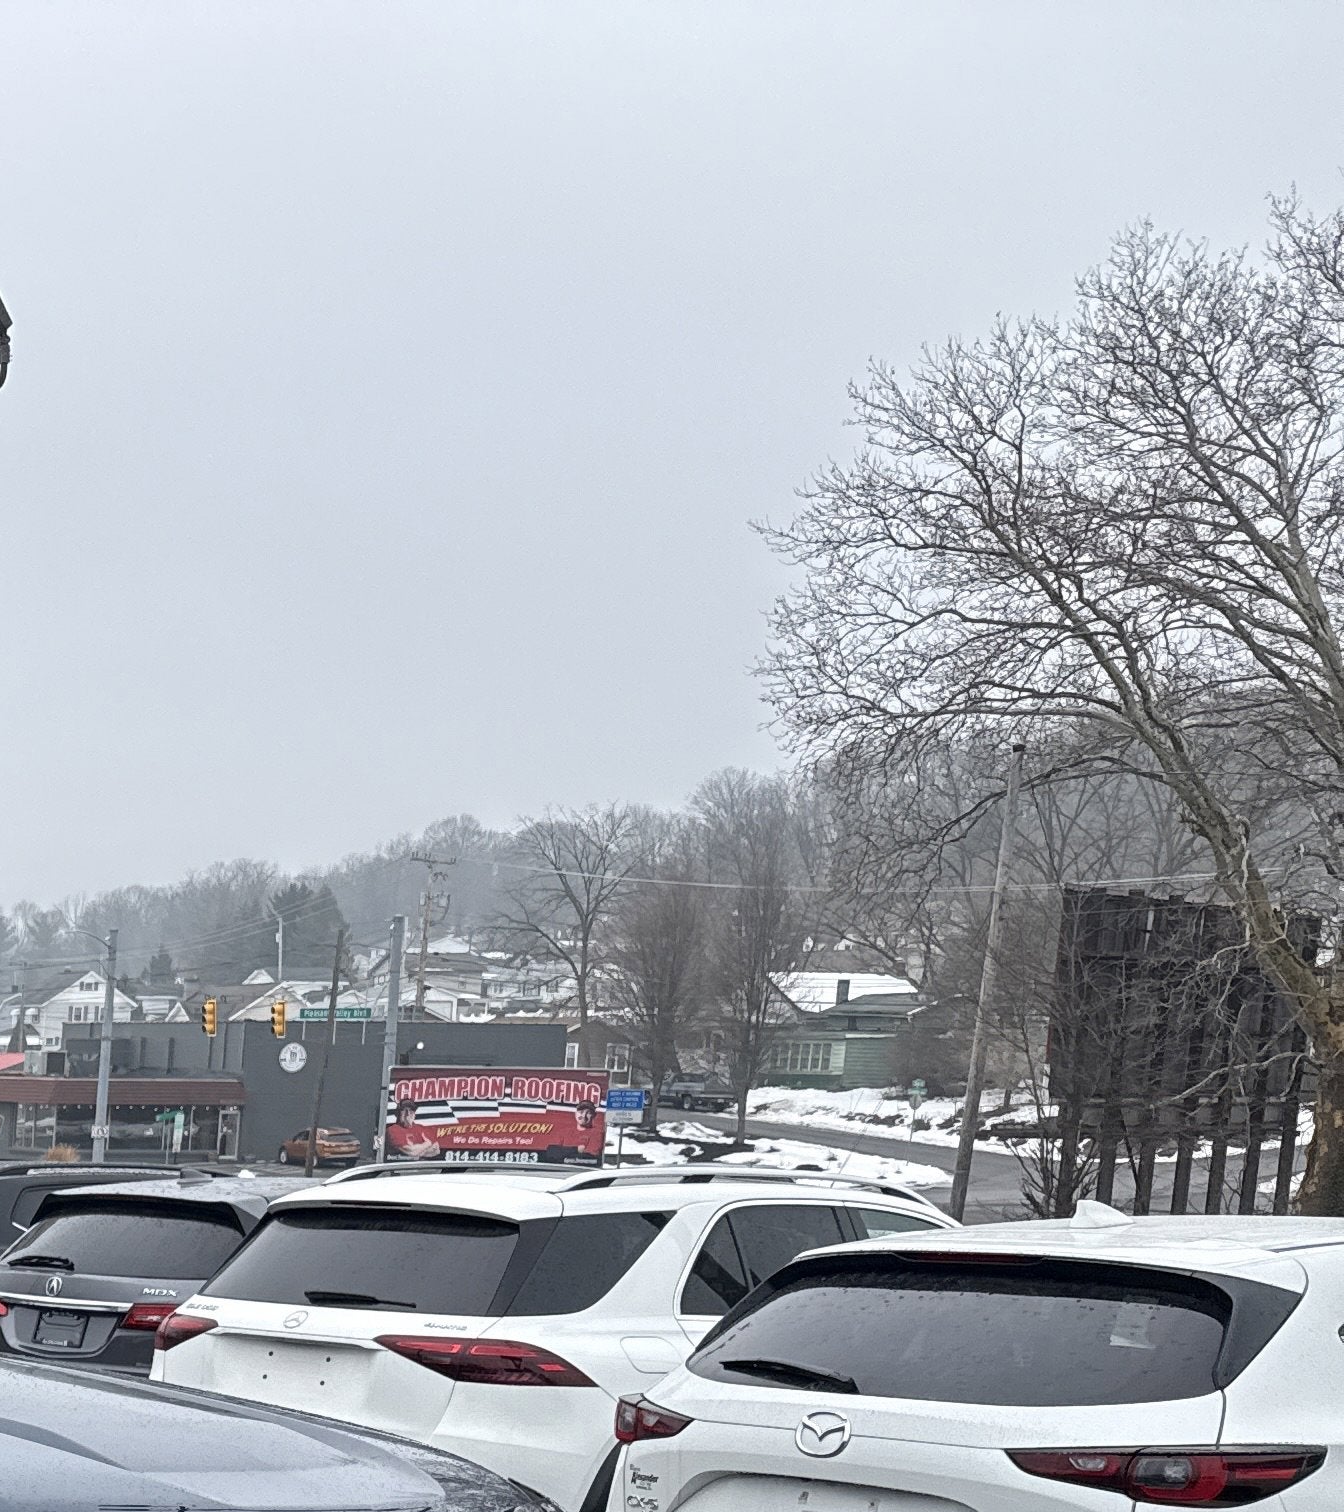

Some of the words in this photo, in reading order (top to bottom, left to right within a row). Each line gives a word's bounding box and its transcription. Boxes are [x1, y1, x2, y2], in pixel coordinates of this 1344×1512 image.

[304, 1009, 328, 1017] Pleasan
[395, 1076, 506, 1103] CHAMPION
[512, 1076, 601, 1104] ROOFING
[436, 1125, 469, 1137] WE'RE
[470, 1123, 489, 1132] THE
[488, 1122, 554, 1135] SOLUTION!
[453, 1135, 466, 1144] We
[467, 1136, 480, 1144] Do
[481, 1136, 513, 1145] Repairs
[515, 1136, 534, 1145] Too!
[445, 1150, 539, 1163] 814-414-8183
[142, 1287, 178, 1297] MDX
